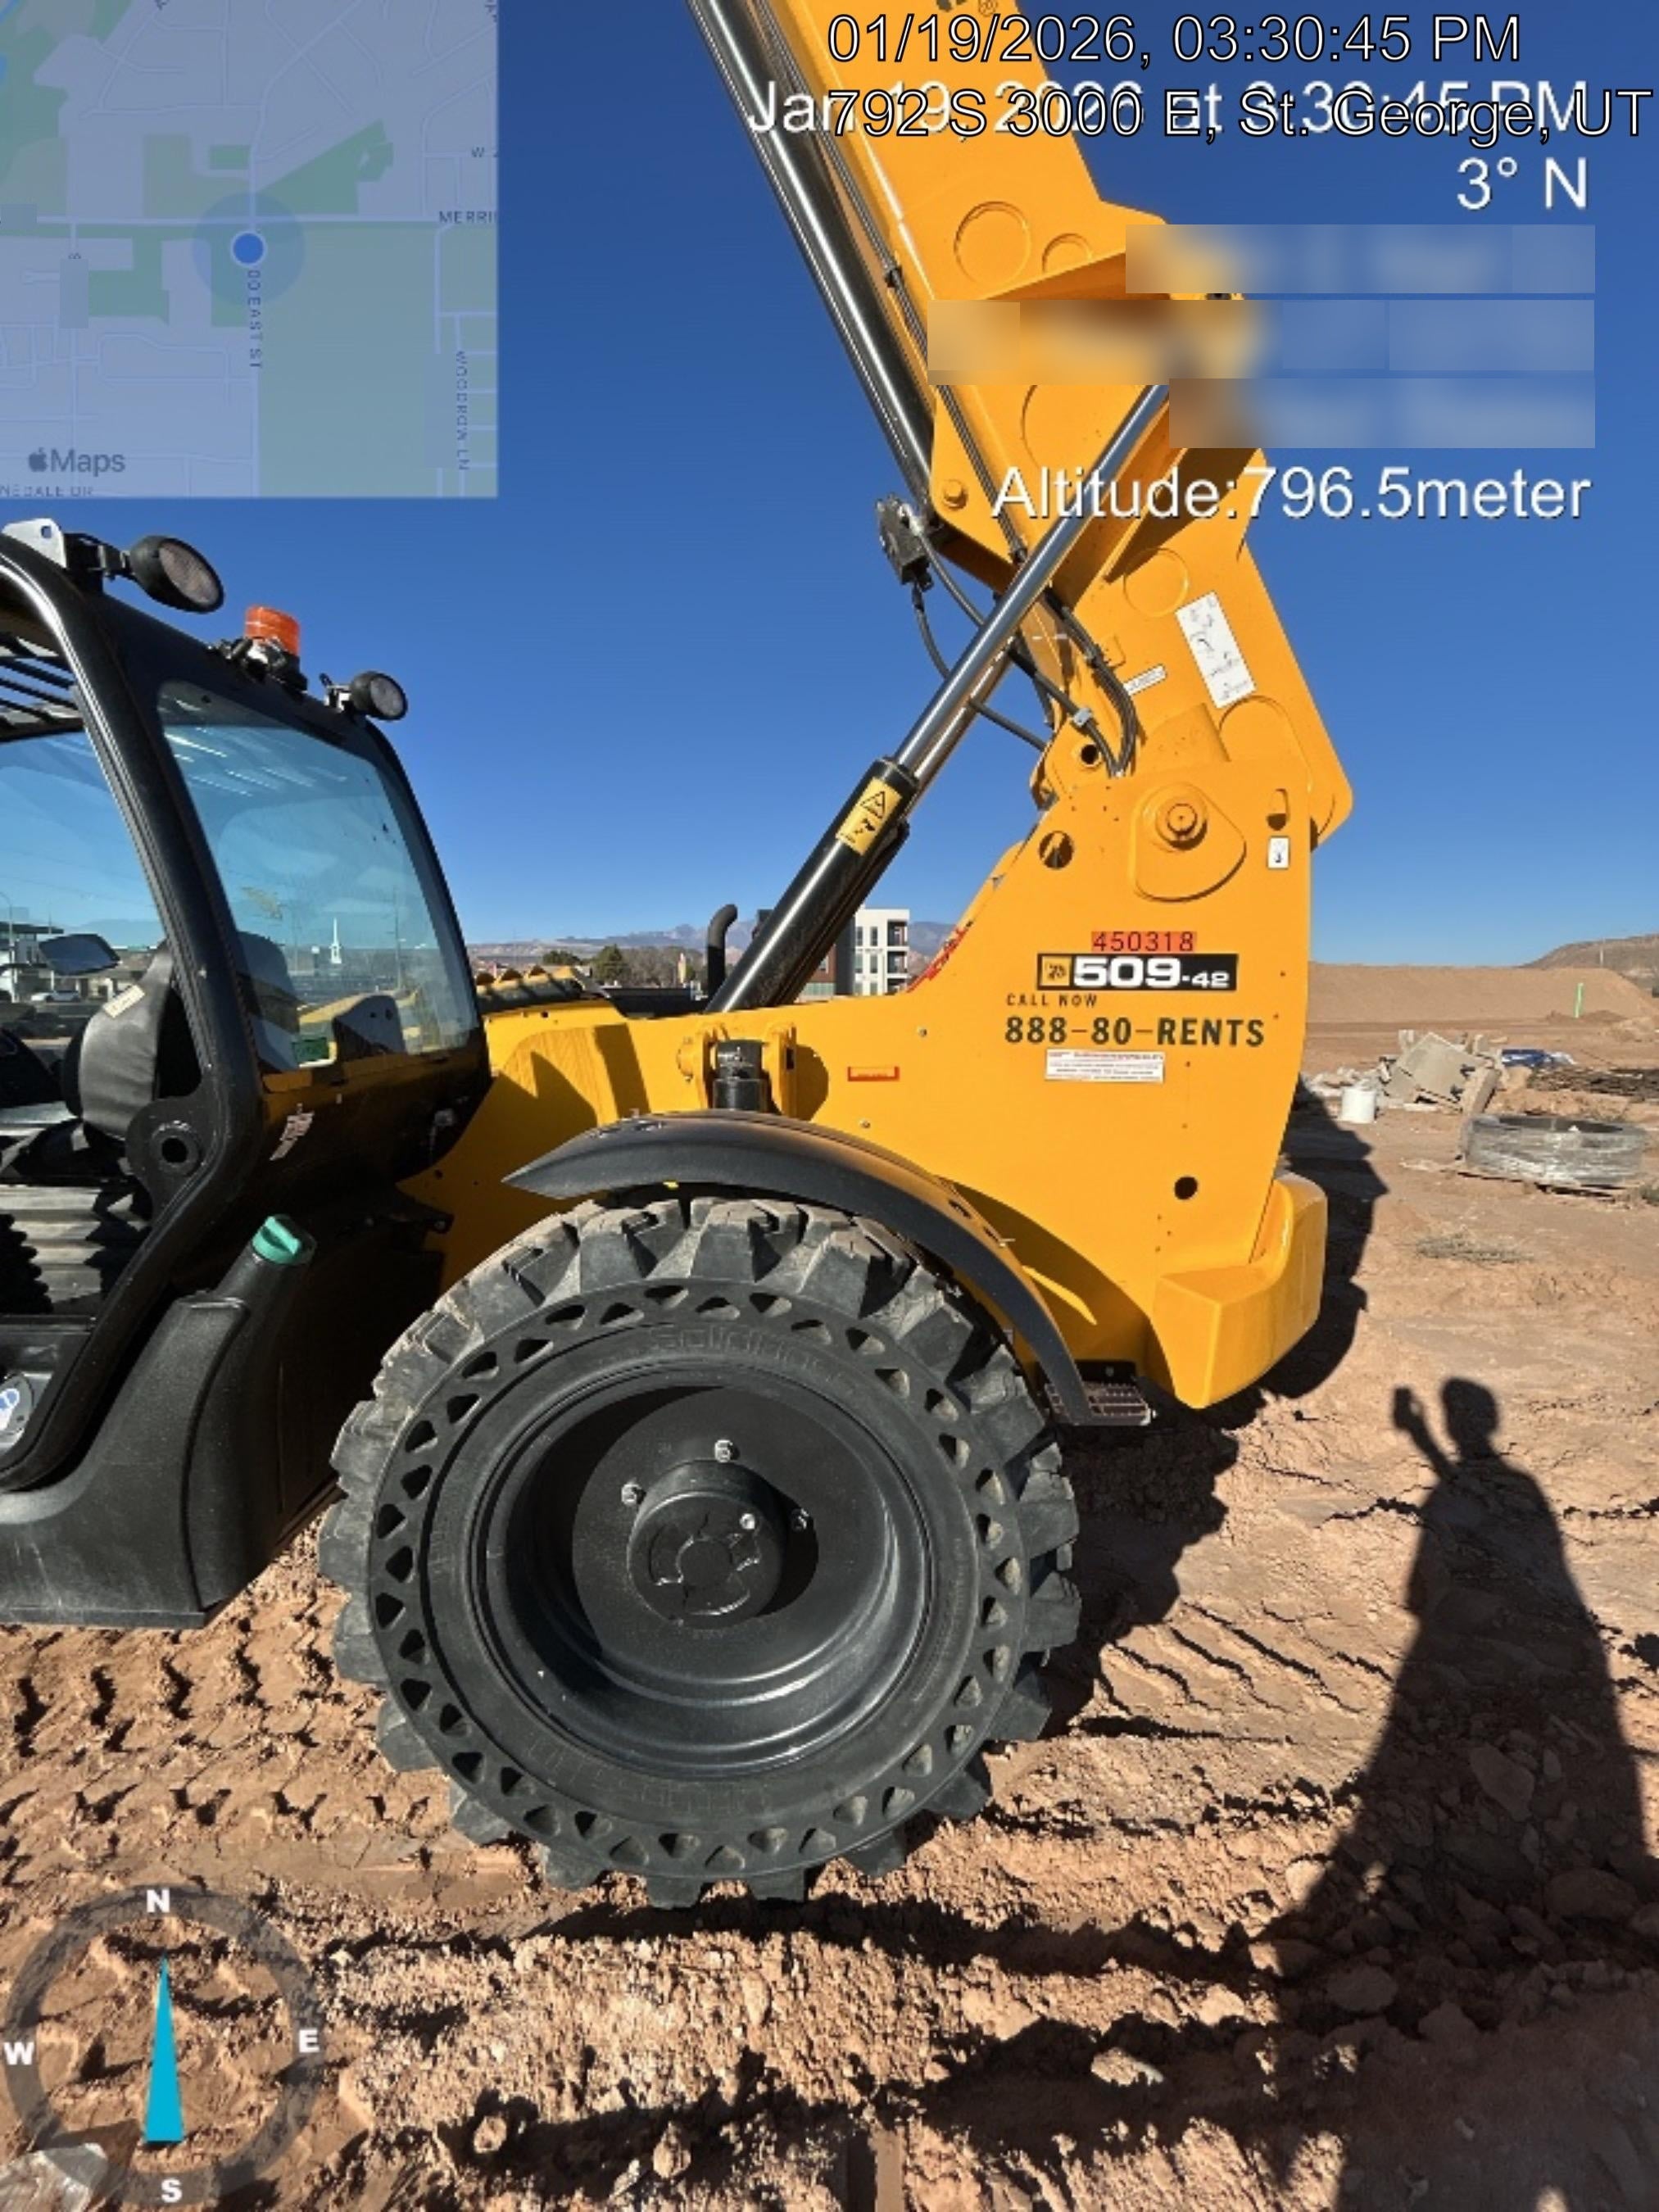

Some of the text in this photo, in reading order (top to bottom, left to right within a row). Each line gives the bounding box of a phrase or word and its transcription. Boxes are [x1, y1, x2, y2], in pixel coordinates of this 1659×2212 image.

[1092, 931, 1194, 952] 450318
[1006, 993, 1098, 1008] CALL NOW
[1004, 1016, 1266, 1046] 888-80-RENTS
